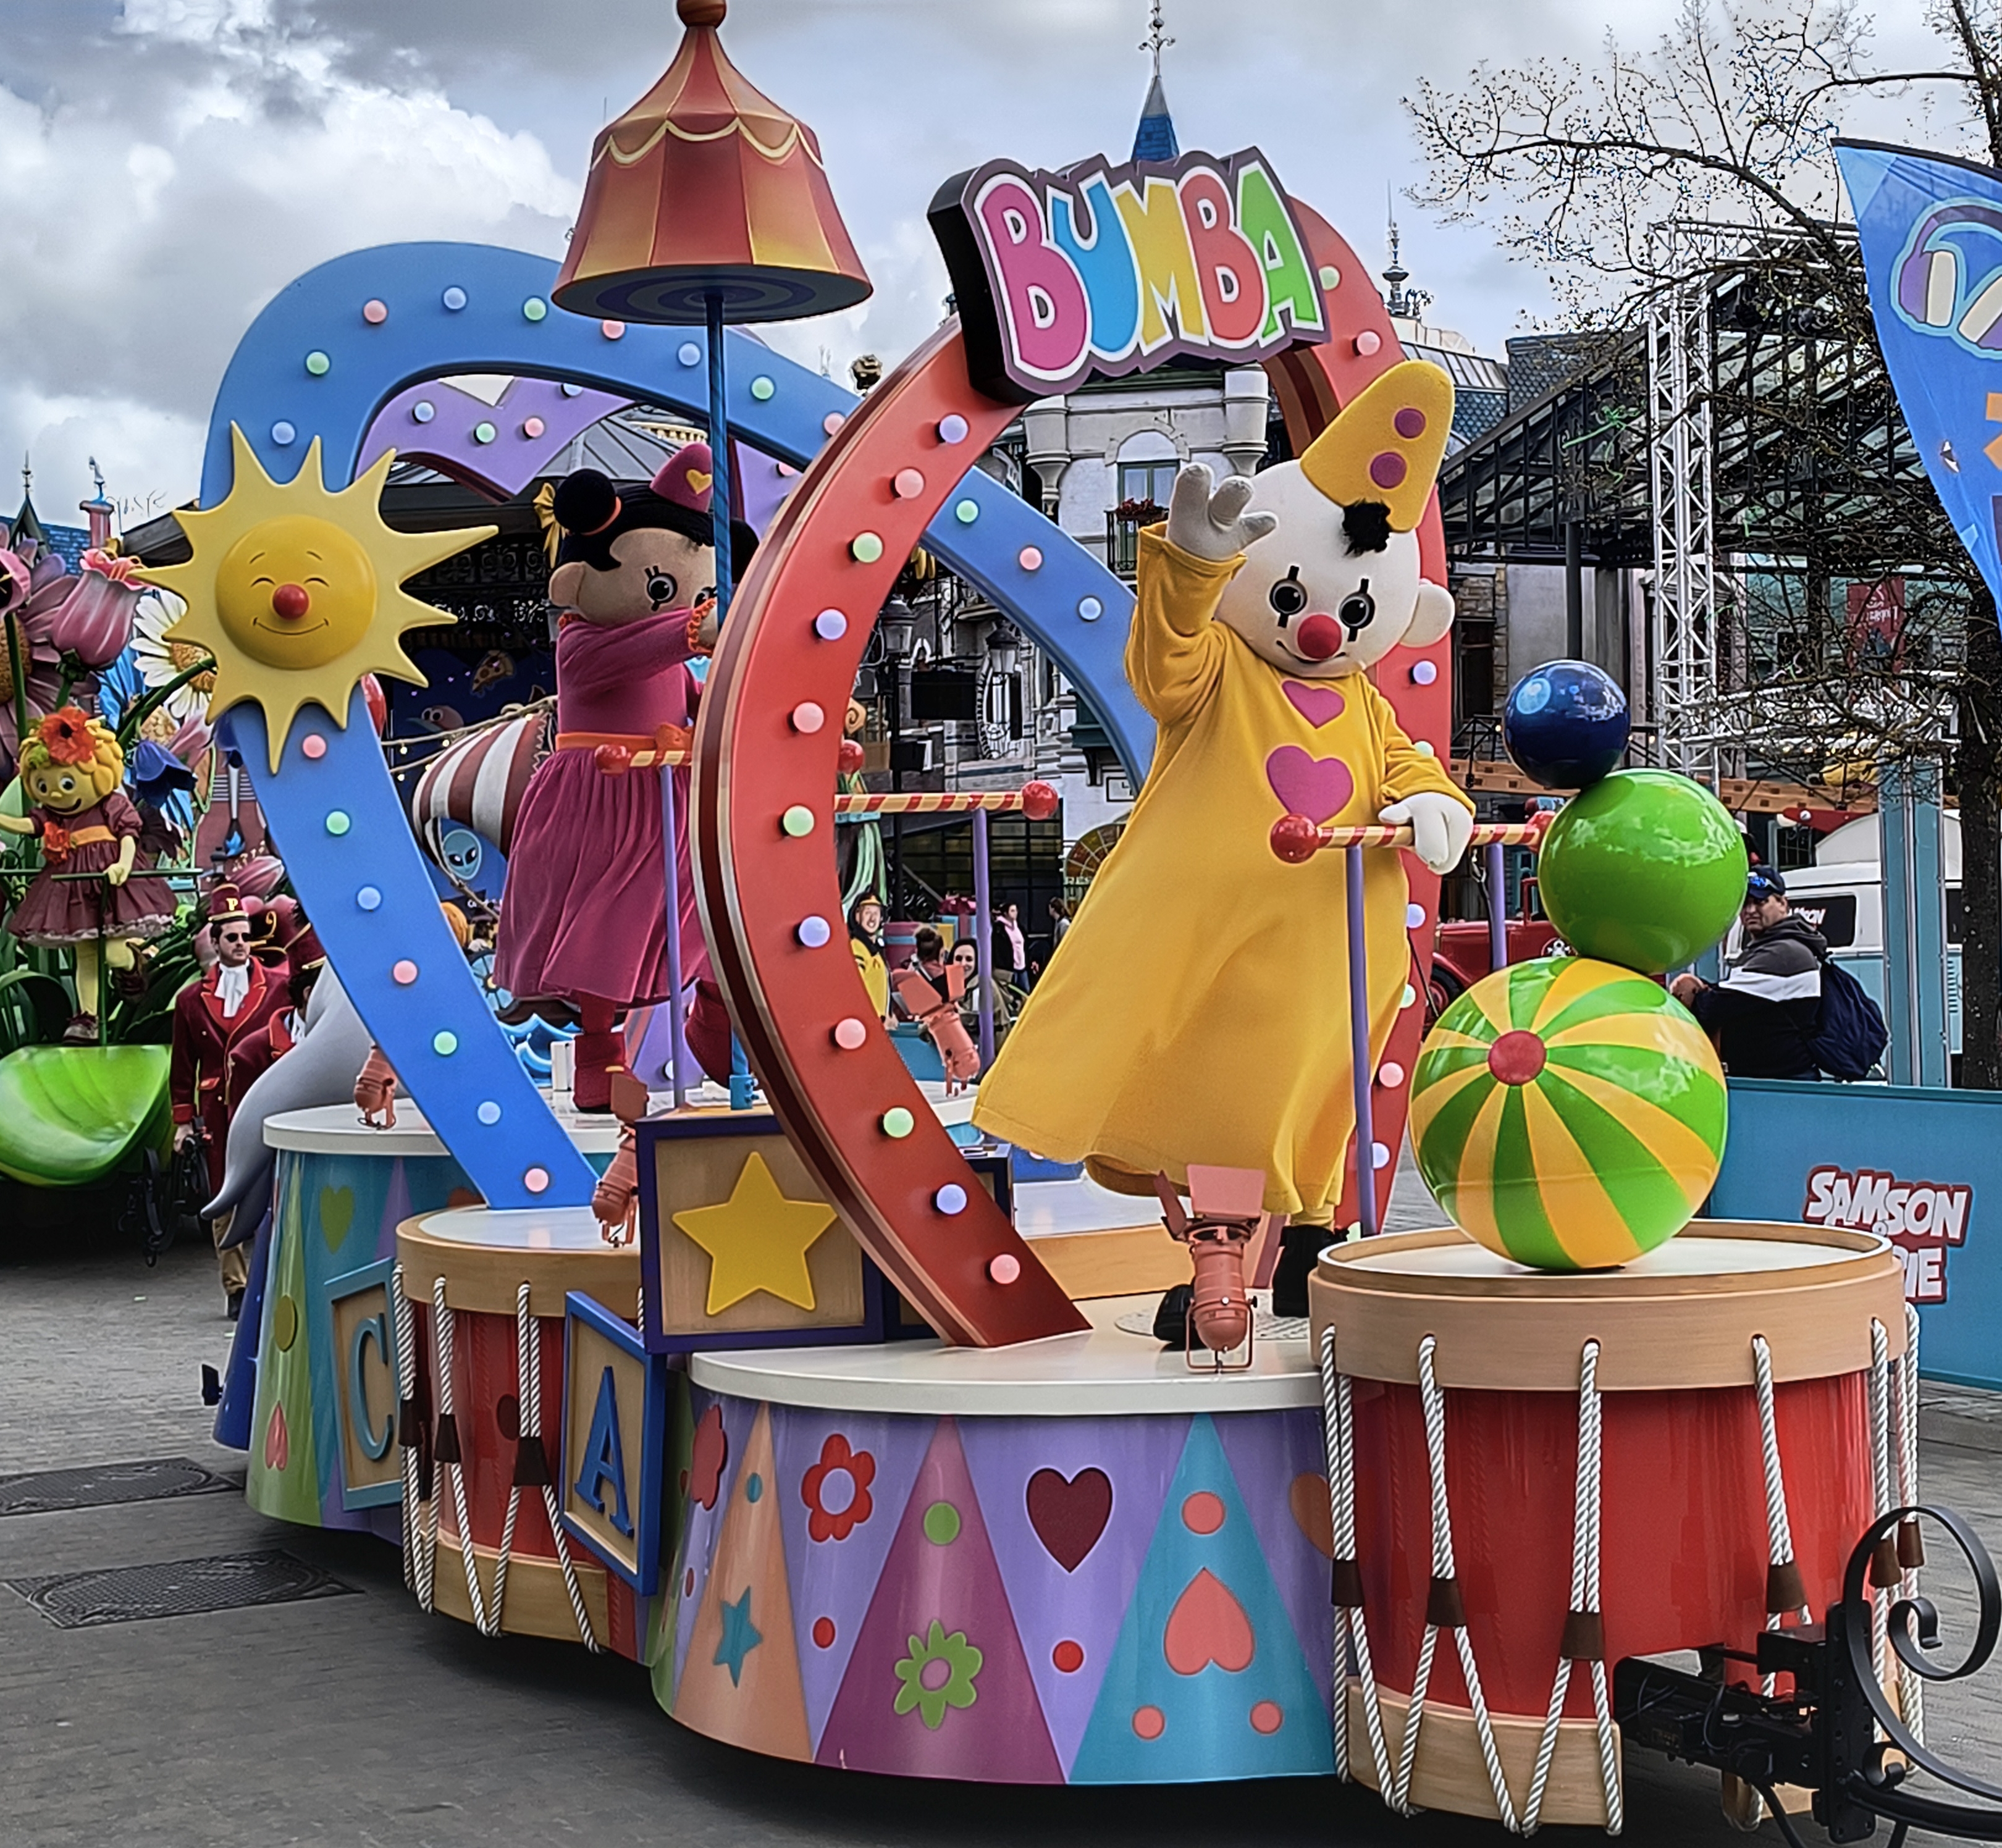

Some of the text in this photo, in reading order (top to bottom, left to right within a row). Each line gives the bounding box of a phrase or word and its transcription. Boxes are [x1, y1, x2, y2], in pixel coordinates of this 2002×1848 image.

[974, 159, 1325, 382] BUMBA
[226, 898, 238, 911] P
[1807, 1171, 1968, 1240] SAMSON
[350, 1312, 395, 1461] C
[574, 1365, 634, 1539] A
